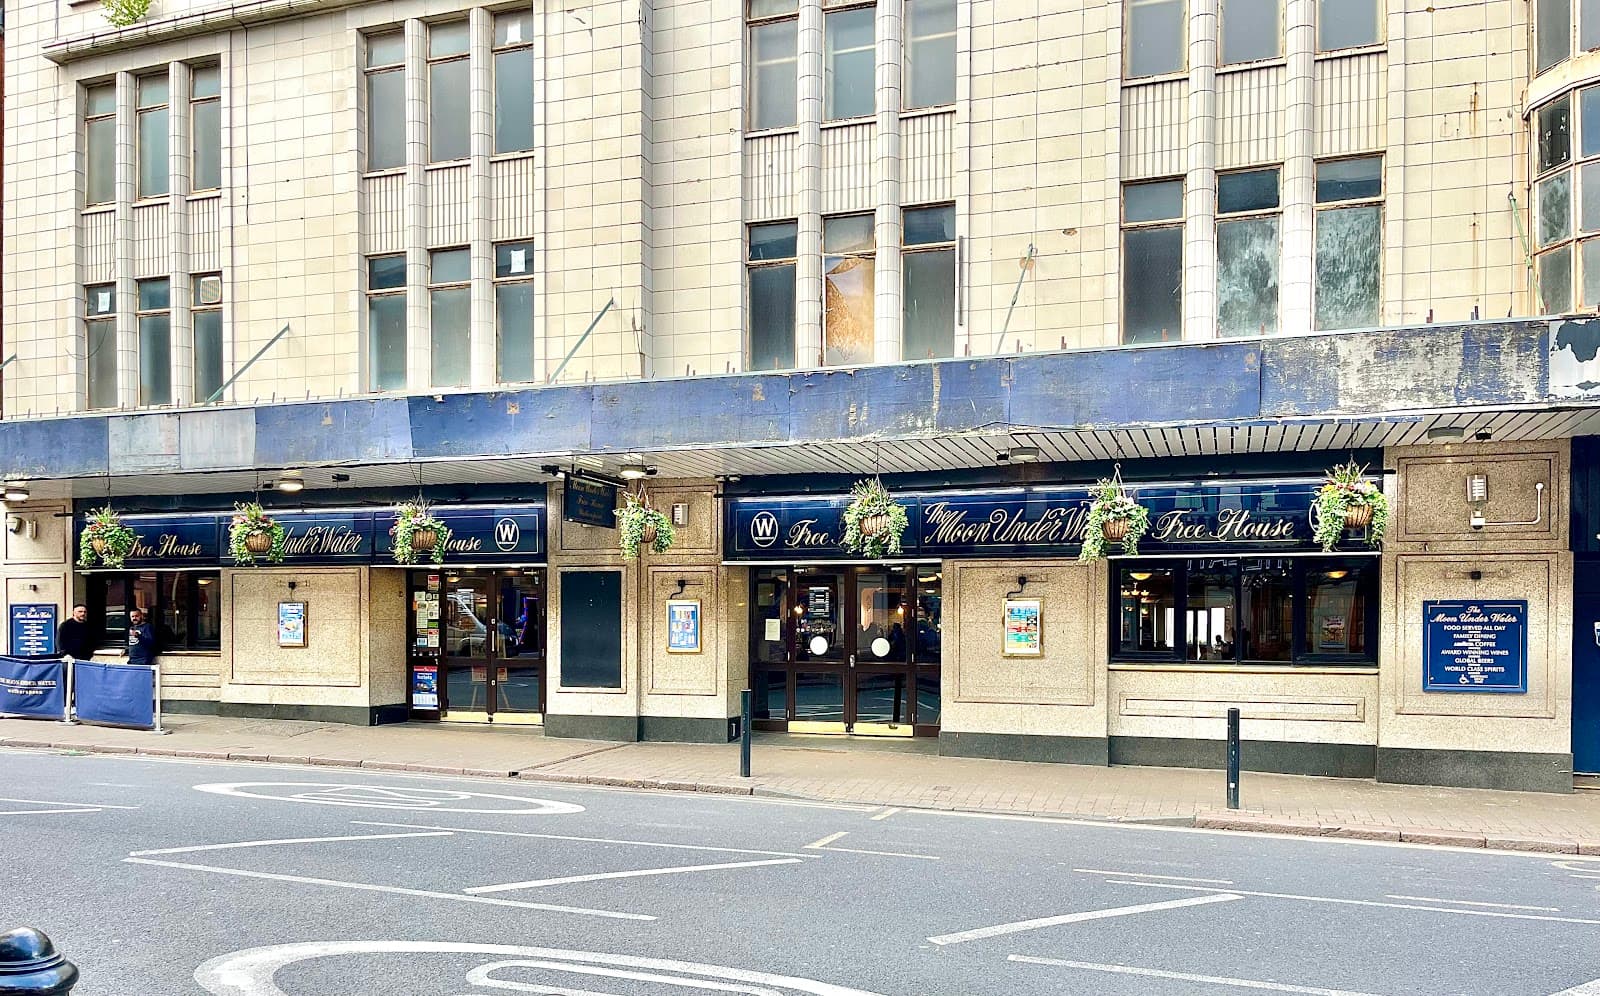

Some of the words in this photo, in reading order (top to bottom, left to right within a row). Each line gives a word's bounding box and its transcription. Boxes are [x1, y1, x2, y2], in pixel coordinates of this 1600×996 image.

[925, 502, 957, 524] The
[990, 508, 1062, 542] Under
[1152, 509, 1206, 542] Free
[1208, 509, 1294, 541] House
[318, 525, 362, 553] Water
[499, 523, 515, 541] W
[754, 518, 774, 536] W
[785, 518, 829, 548] Free
[925, 510, 990, 544] Moon
[154, 533, 202, 558] House
[1430, 613, 1457, 622] Moon
[1459, 613, 1489, 623] Under
[1490, 613, 1517, 623] Water
[1466, 605, 1480, 613] The
